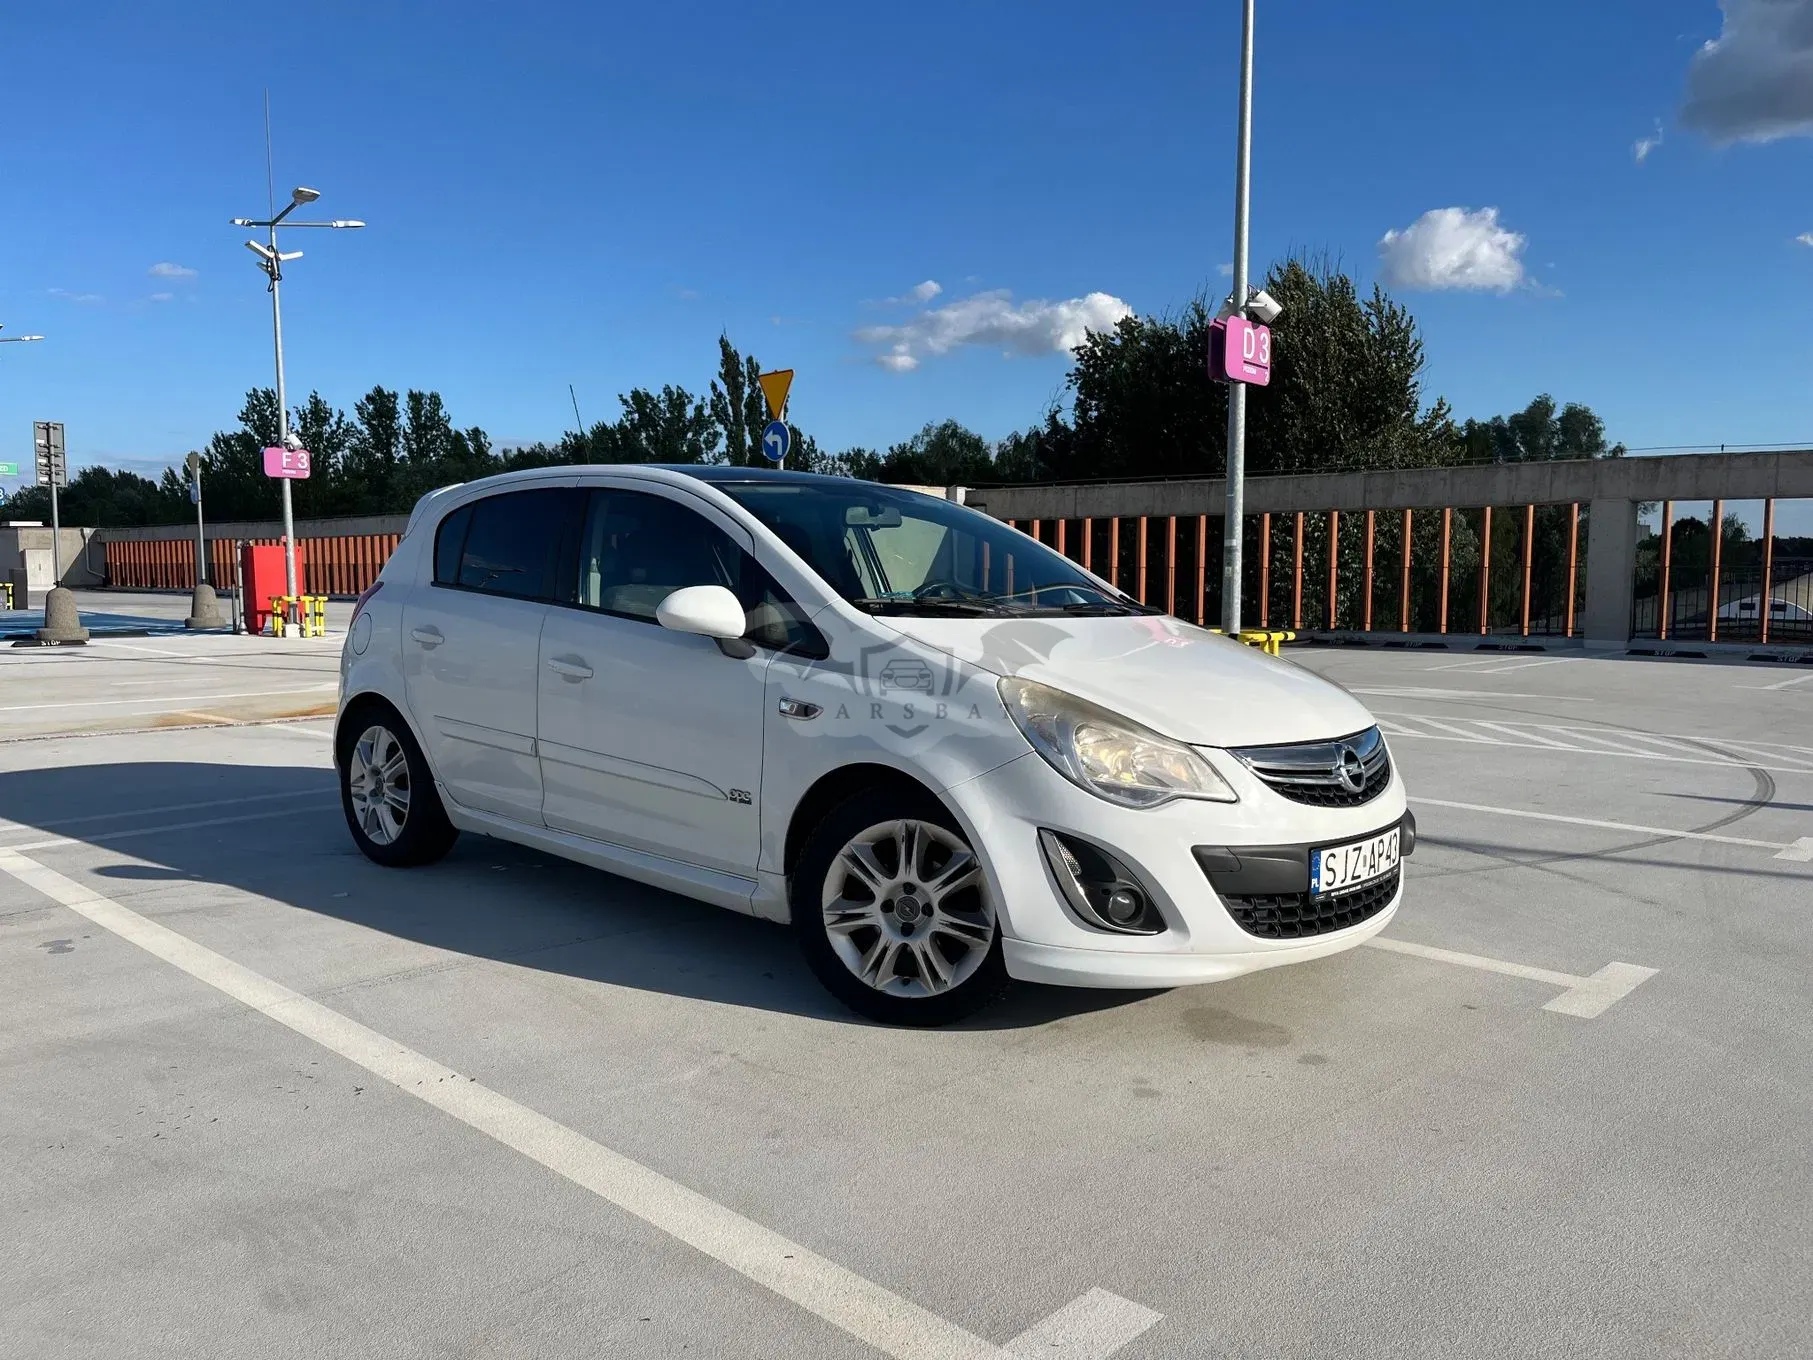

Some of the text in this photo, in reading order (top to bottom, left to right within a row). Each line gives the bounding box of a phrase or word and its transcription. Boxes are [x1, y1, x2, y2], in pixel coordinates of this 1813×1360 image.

[1243, 327, 1269, 364] D 3
[282, 452, 308, 469] F 3
[1325, 832, 1398, 887] SJZ AP43
